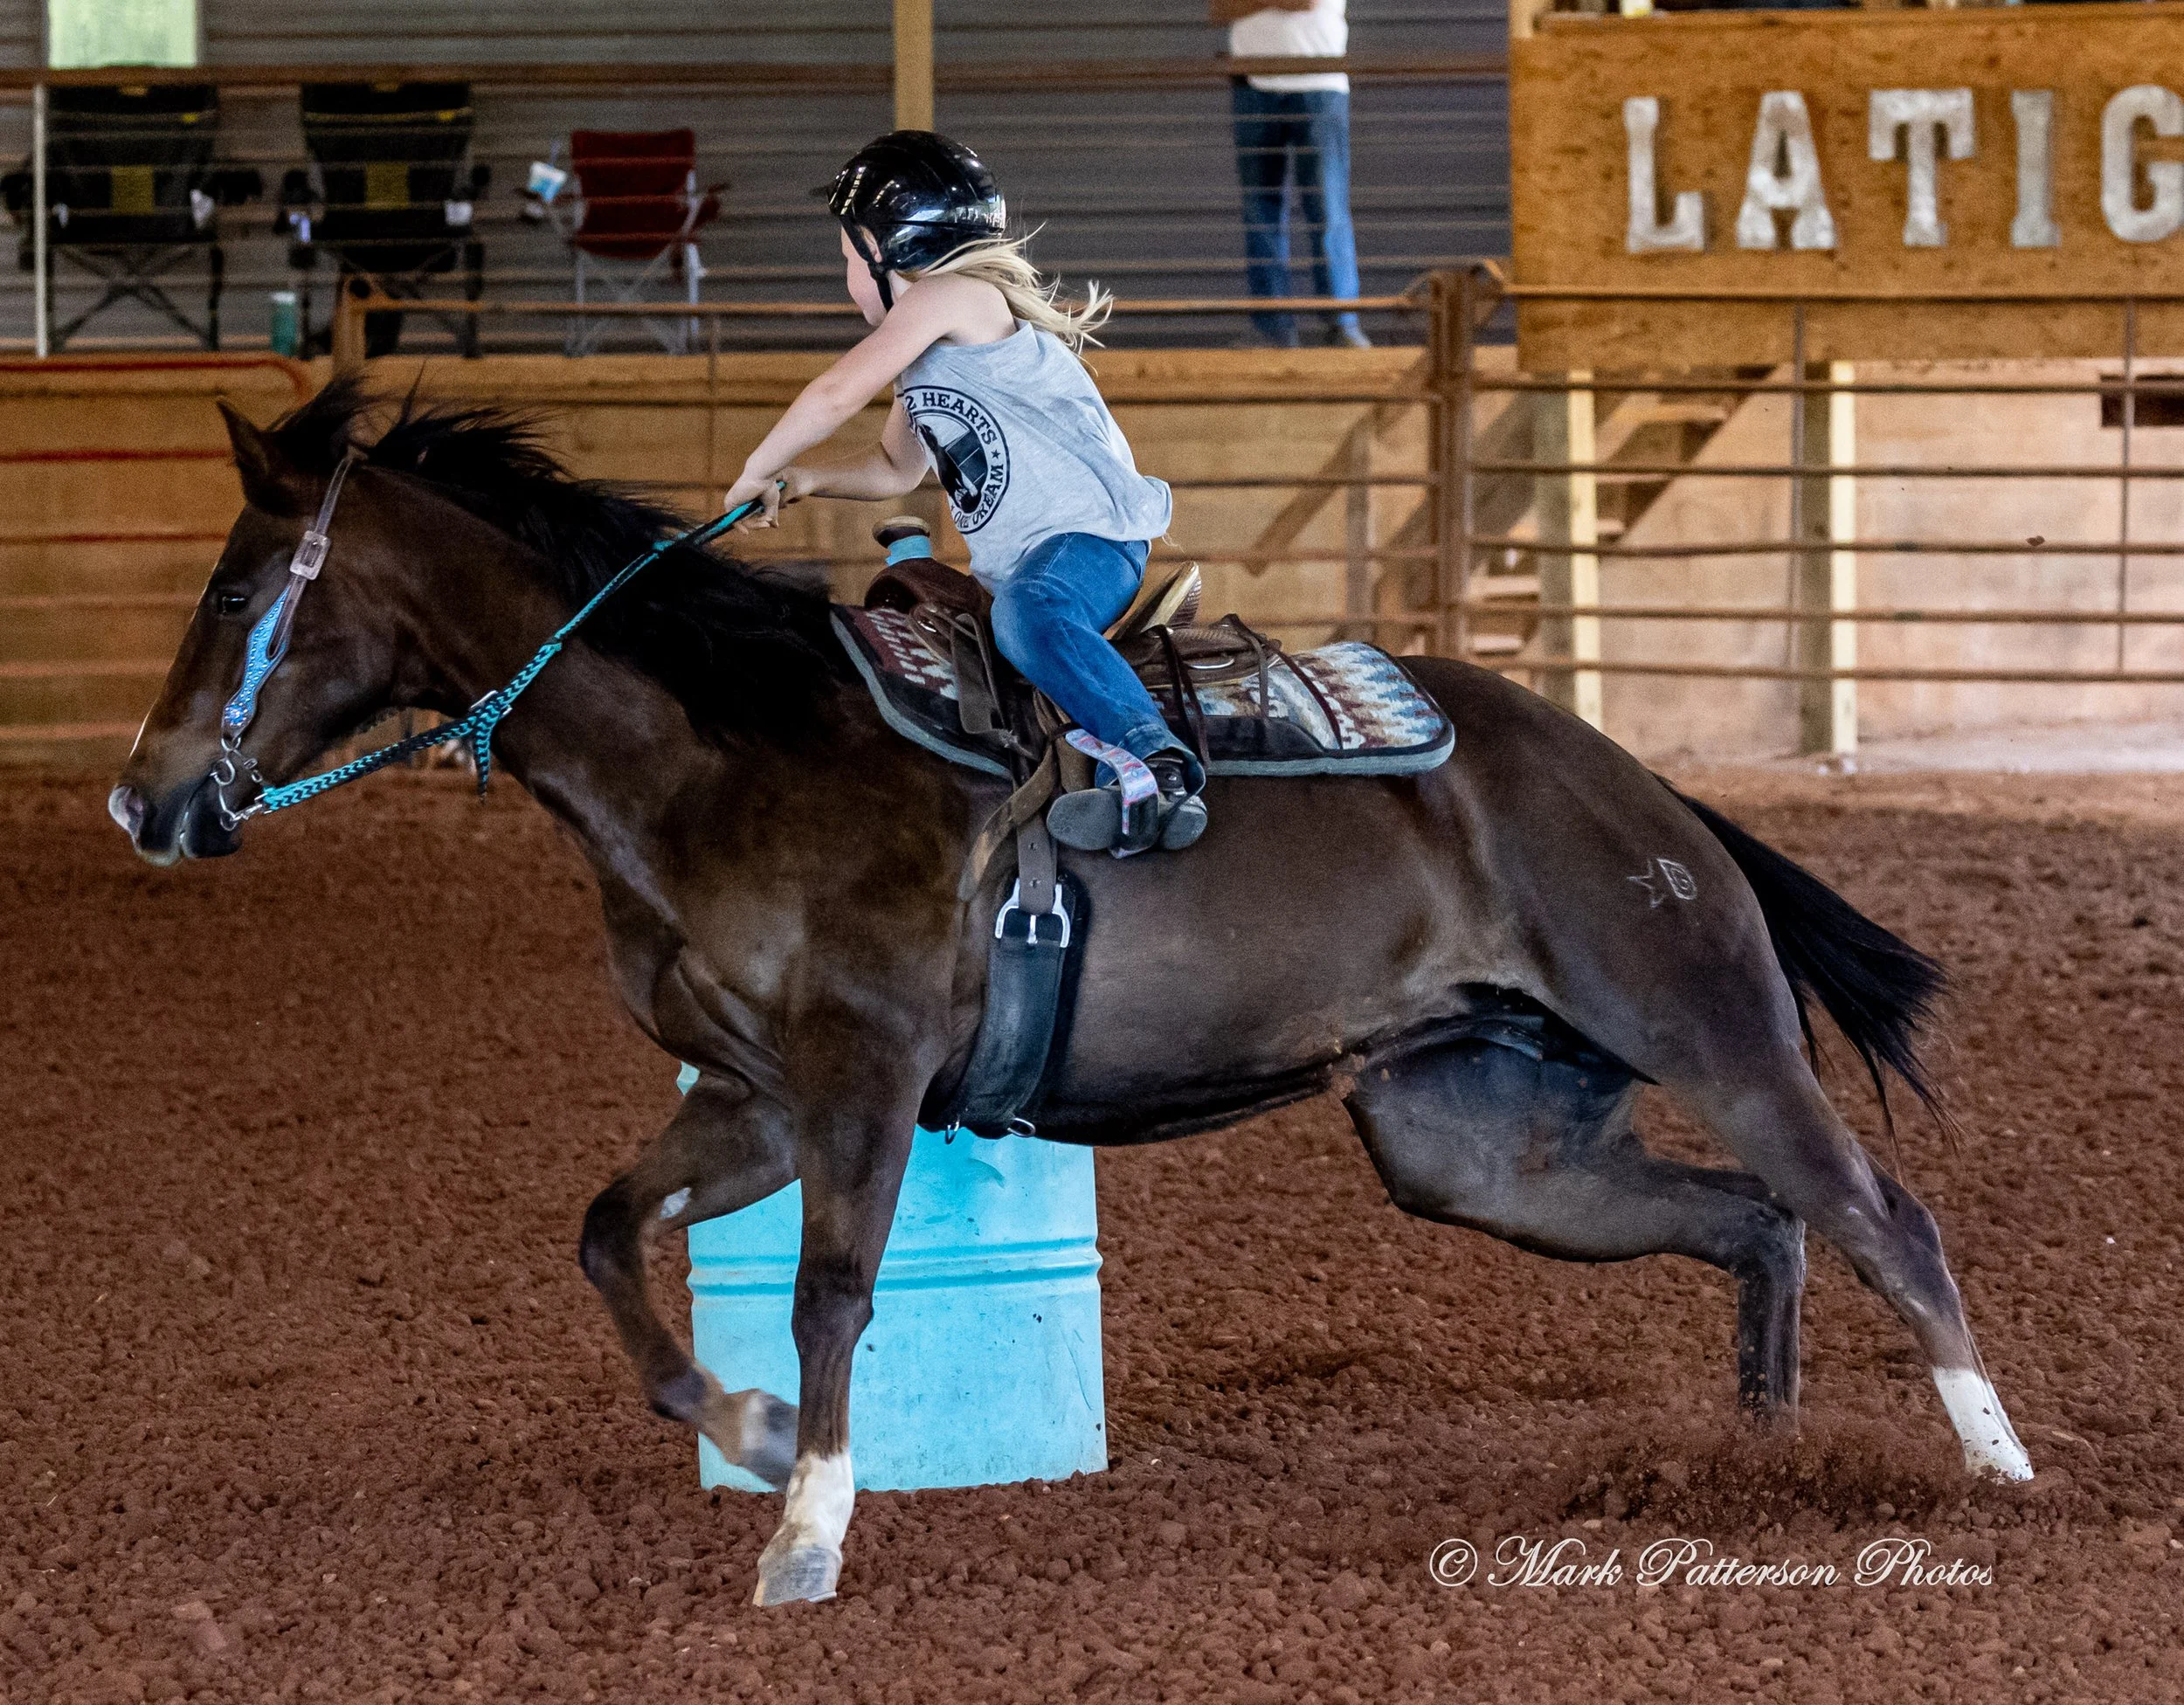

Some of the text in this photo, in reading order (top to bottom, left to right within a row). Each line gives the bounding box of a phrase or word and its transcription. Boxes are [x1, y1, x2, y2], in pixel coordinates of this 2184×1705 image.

[1623, 85, 2184, 252] LATIG
[905, 392, 998, 445] 2 HEARTS
